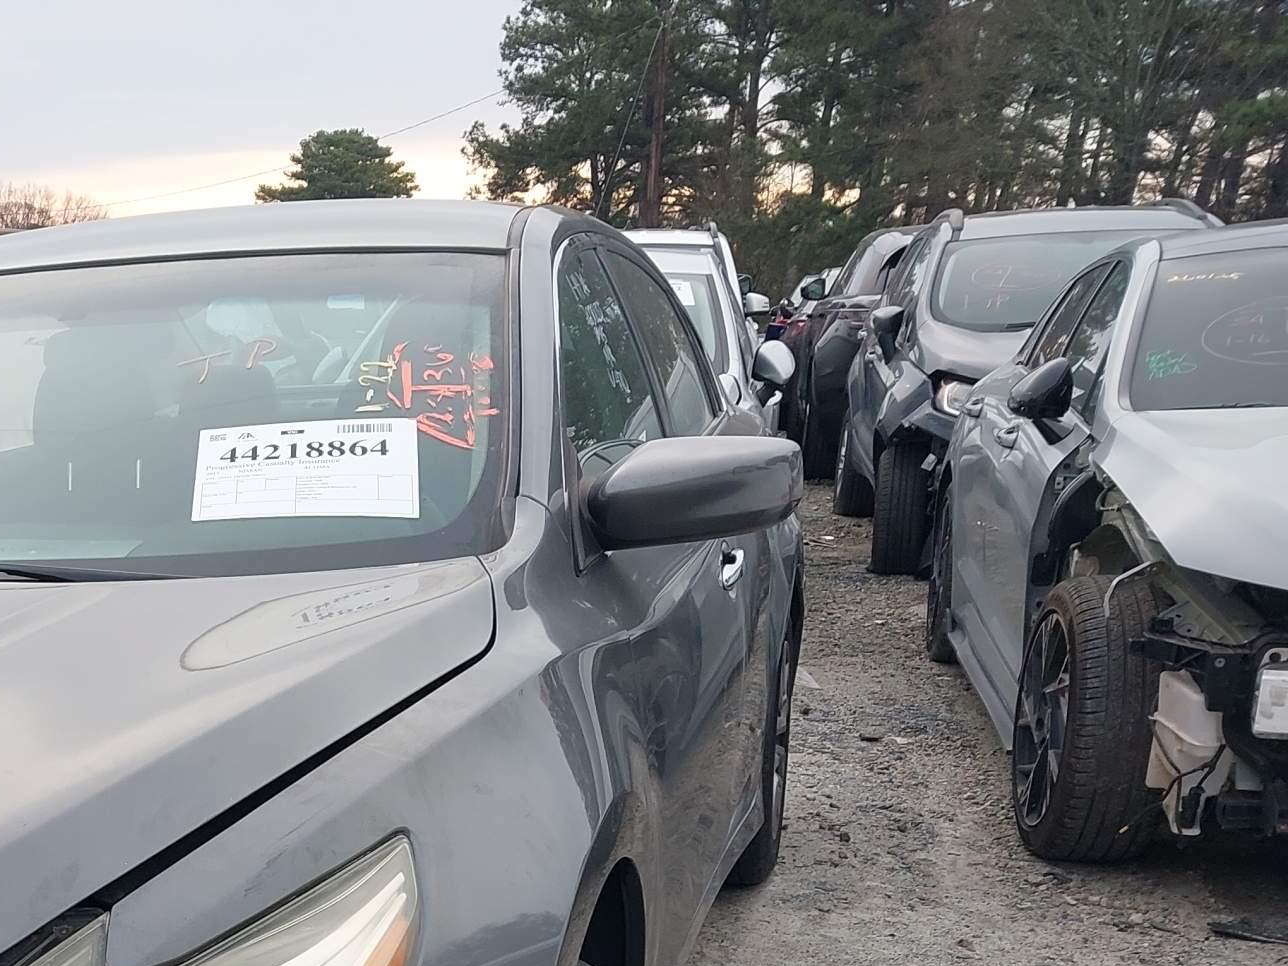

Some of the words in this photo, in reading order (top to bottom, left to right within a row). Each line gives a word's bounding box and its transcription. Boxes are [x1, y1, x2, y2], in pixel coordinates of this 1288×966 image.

[219, 438, 390, 463] 44218864
[205, 462, 257, 471] Progressive
[258, 459, 295, 468] Casualty
[298, 457, 341, 465] Insurance
